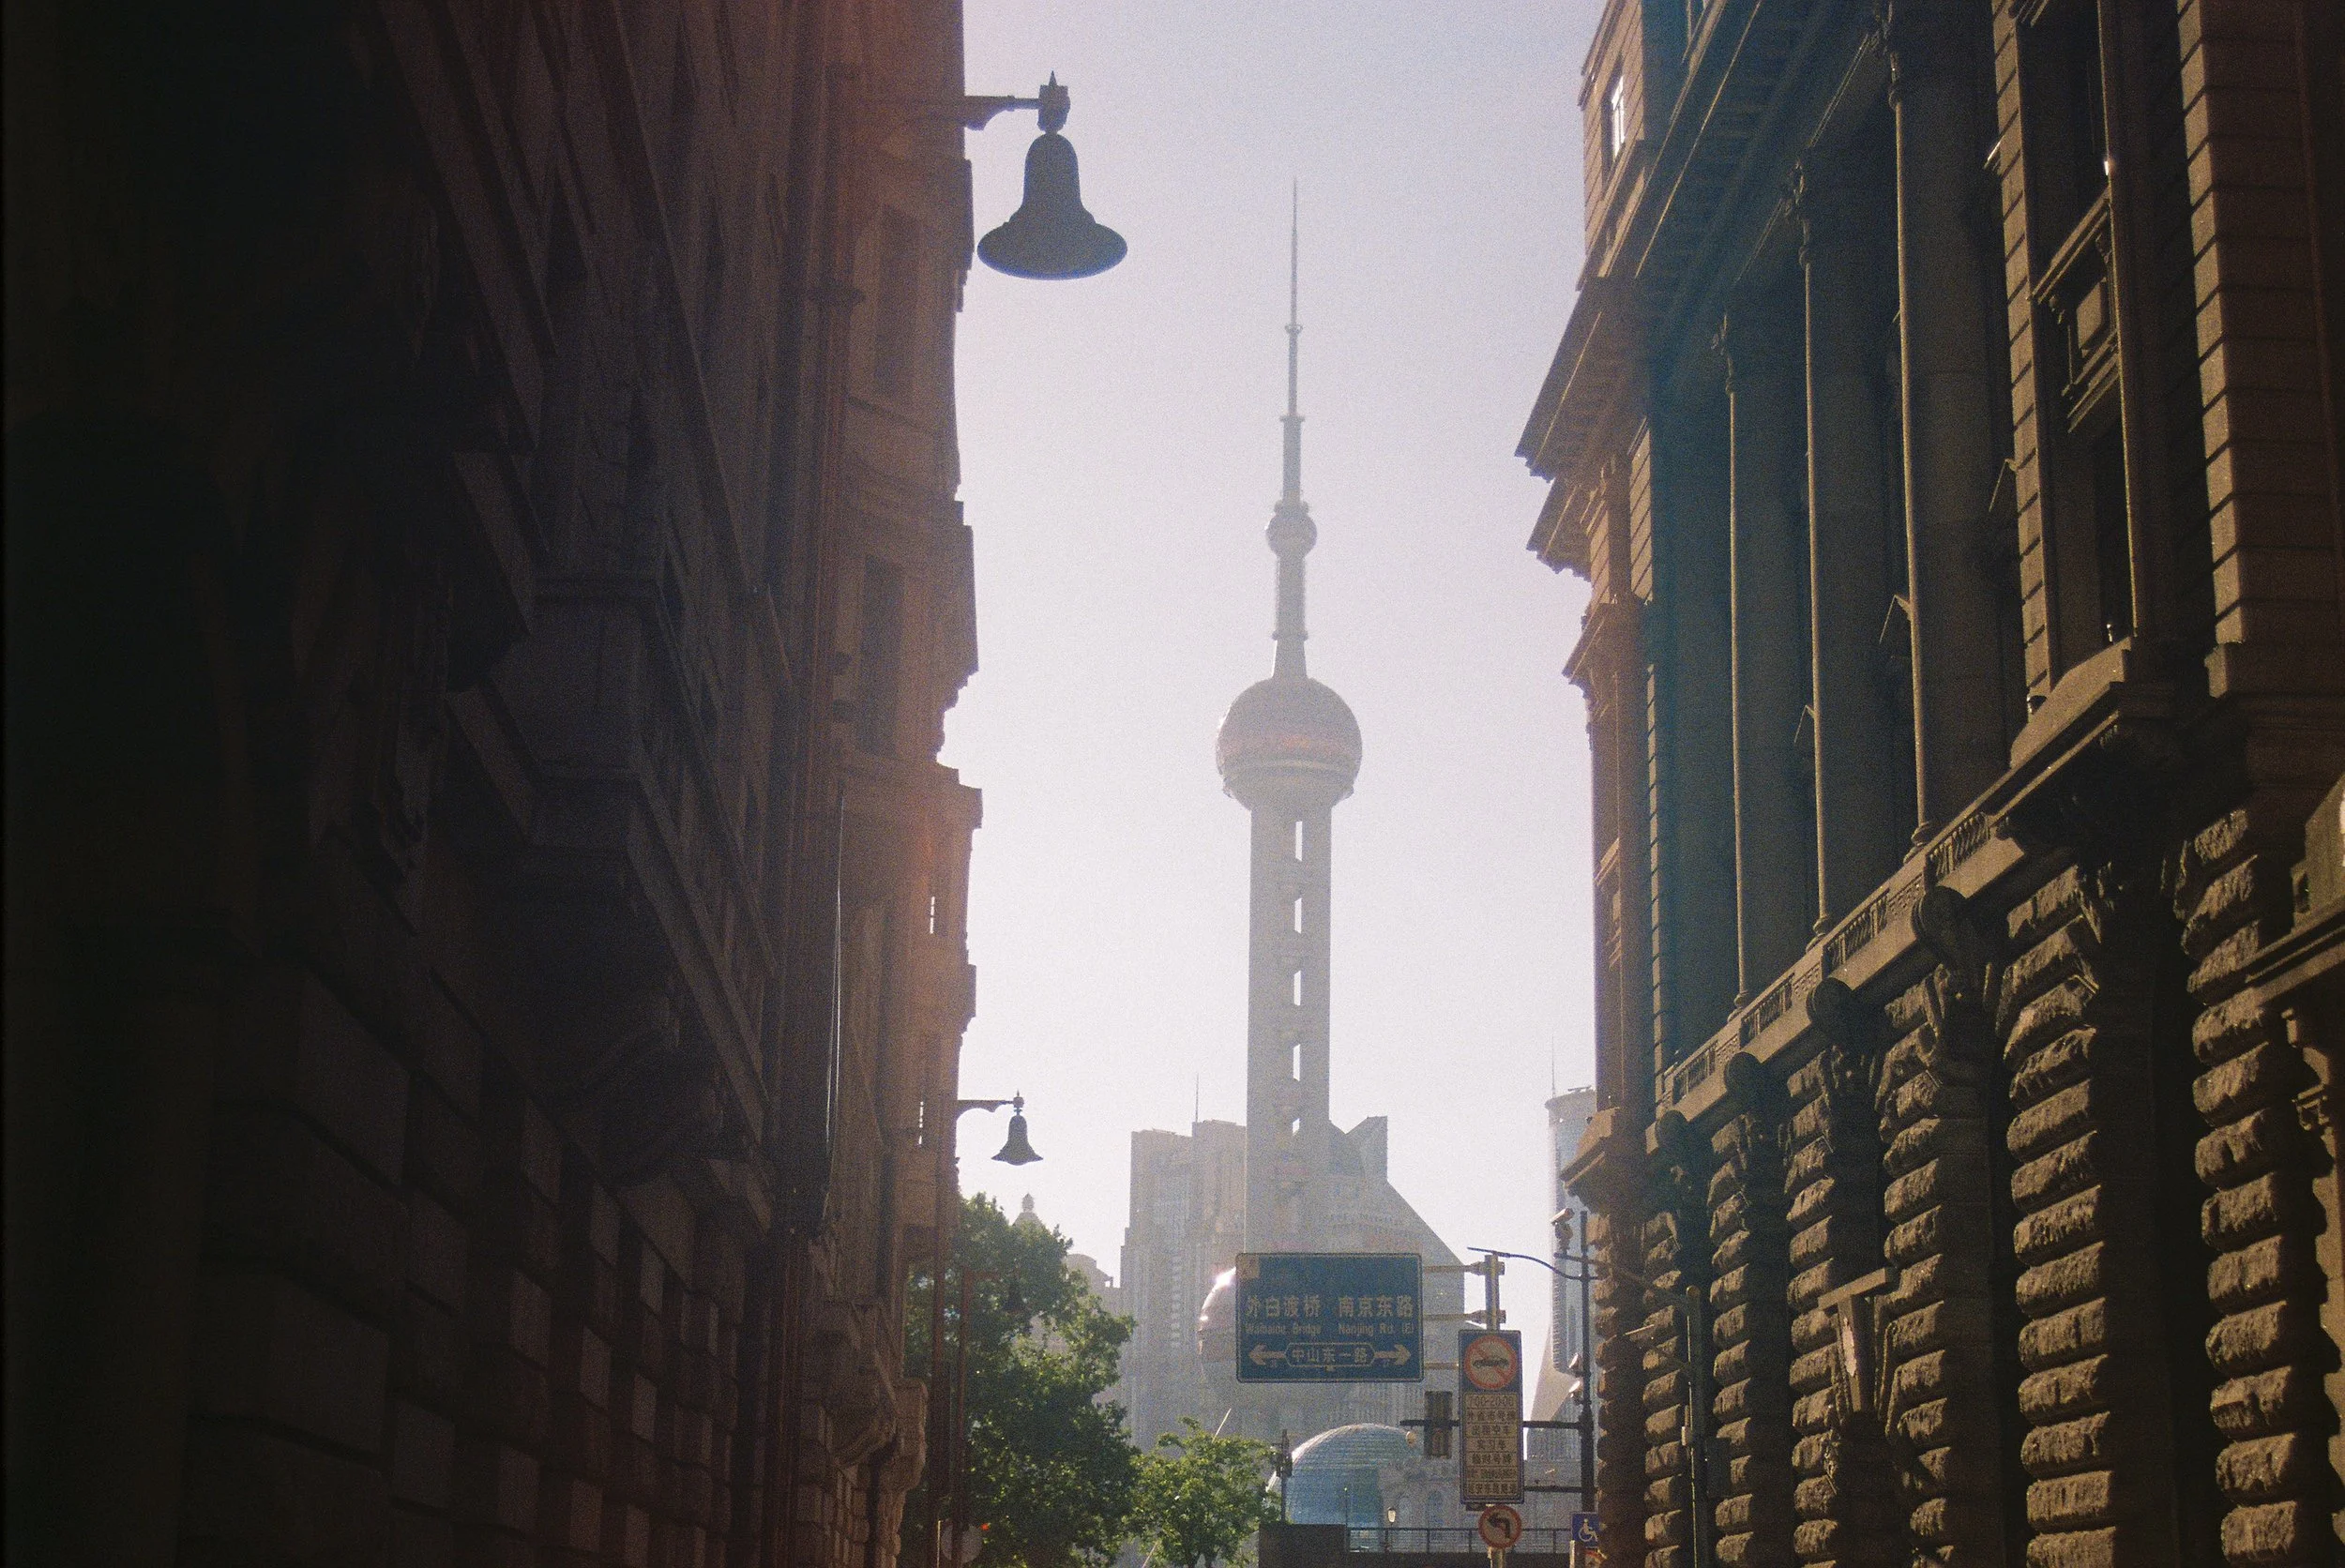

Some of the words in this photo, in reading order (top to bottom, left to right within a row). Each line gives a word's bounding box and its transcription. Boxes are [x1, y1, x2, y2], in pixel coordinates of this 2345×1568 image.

[1245, 1294, 1321, 1318] 外白渡桥
[1338, 1294, 1414, 1318] 南京东路
[1338, 1322, 1374, 1337] Nanjing
[1292, 1347, 1368, 1363] 中山东一路
